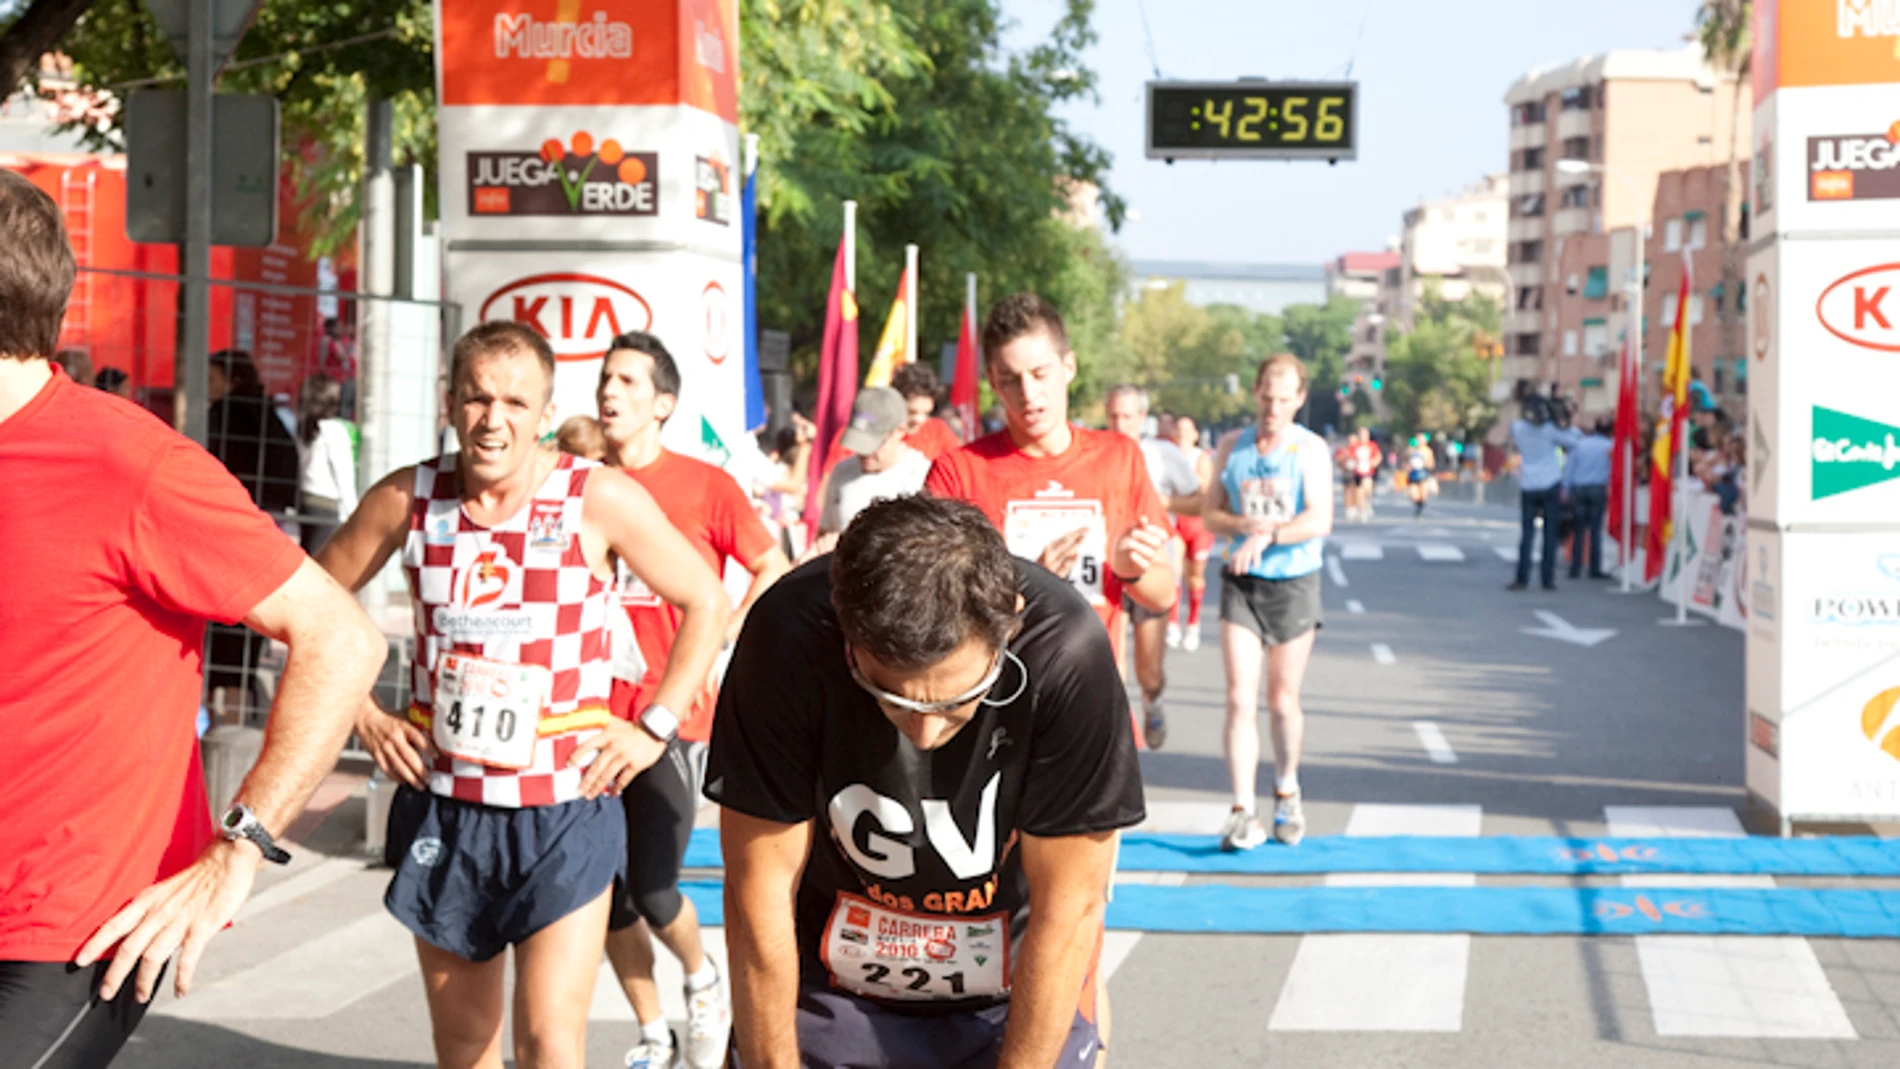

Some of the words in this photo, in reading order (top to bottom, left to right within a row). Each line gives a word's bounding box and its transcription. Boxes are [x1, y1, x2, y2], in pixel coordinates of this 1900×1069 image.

[494, 10, 633, 59] Murcia
[473, 156, 562, 187] JUEGA
[512, 295, 622, 340] KIA
[446, 700, 517, 743] 410
[828, 770, 1001, 880] GV
[878, 916, 957, 940] CARRERA
[876, 941, 919, 959] 2010
[861, 962, 965, 994] 221
